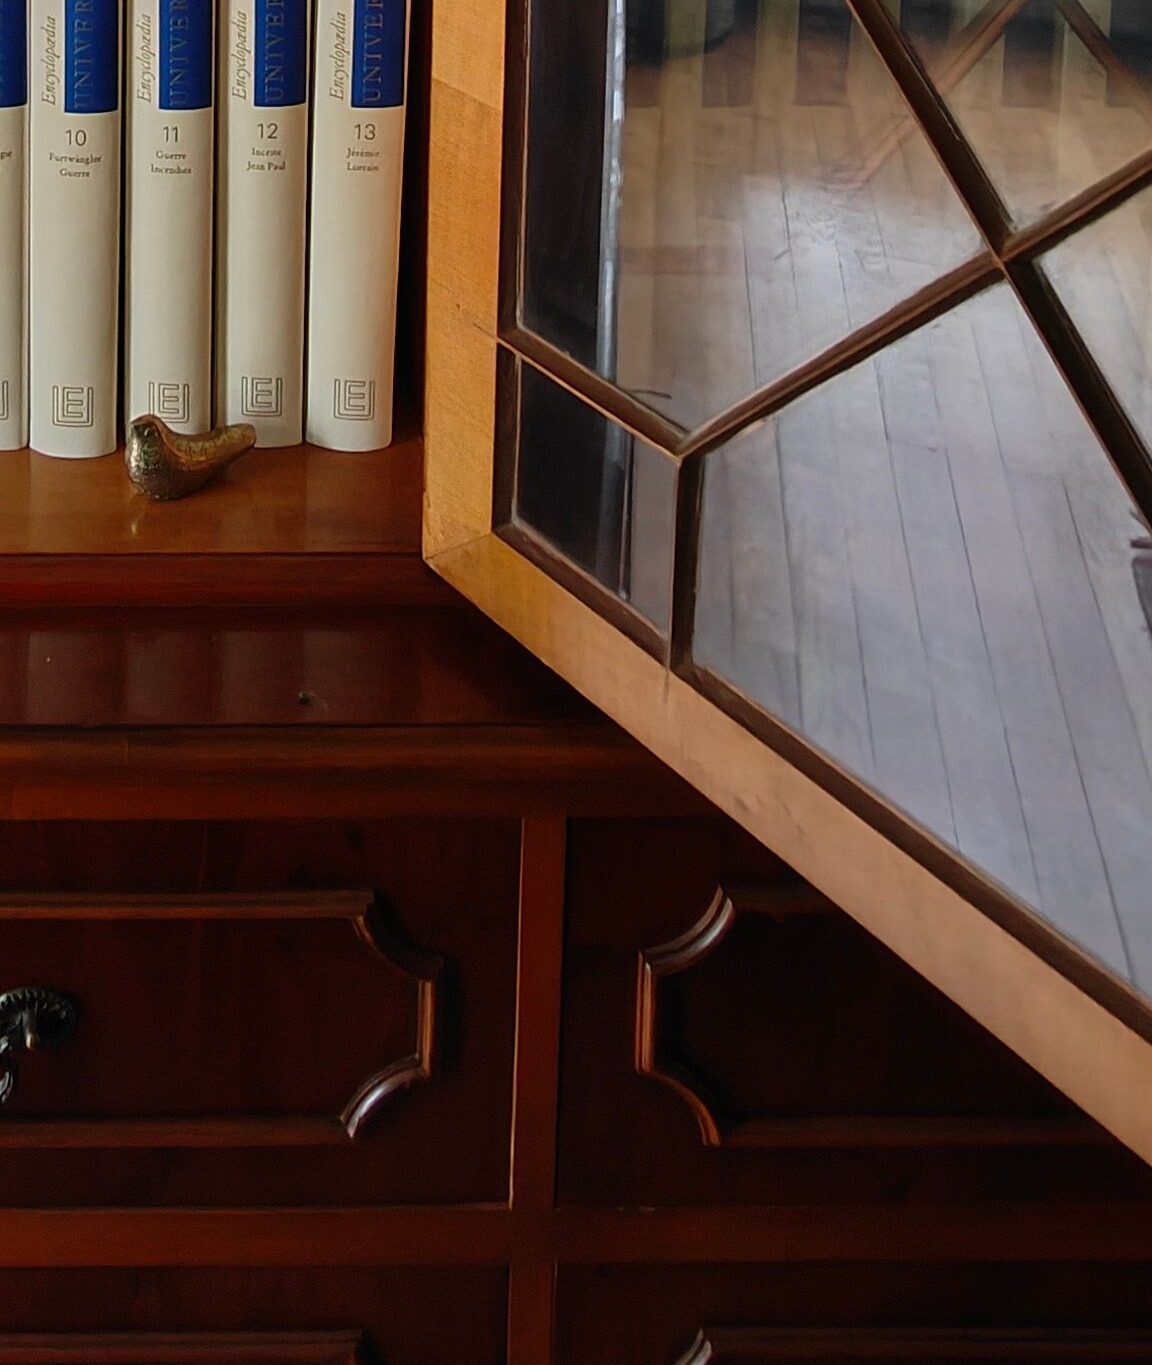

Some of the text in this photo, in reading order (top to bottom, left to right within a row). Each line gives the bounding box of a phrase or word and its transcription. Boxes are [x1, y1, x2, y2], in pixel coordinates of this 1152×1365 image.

[41, 15, 61, 106] Encyclopædia
[136, 13, 157, 104] Encyclopædia
[231, 10, 252, 101] Encyclopædia
[329, 10, 351, 101] Encyclopædia
[65, 129, 88, 147] 10
[162, 125, 180, 144] 11
[256, 122, 279, 140] 12
[353, 123, 377, 141] 13
[155, 149, 187, 161] Guerre
[250, 147, 283, 158] Inceste
[58, 167, 91, 179] Guerre
[246, 160, 286, 172] Jean Paul
